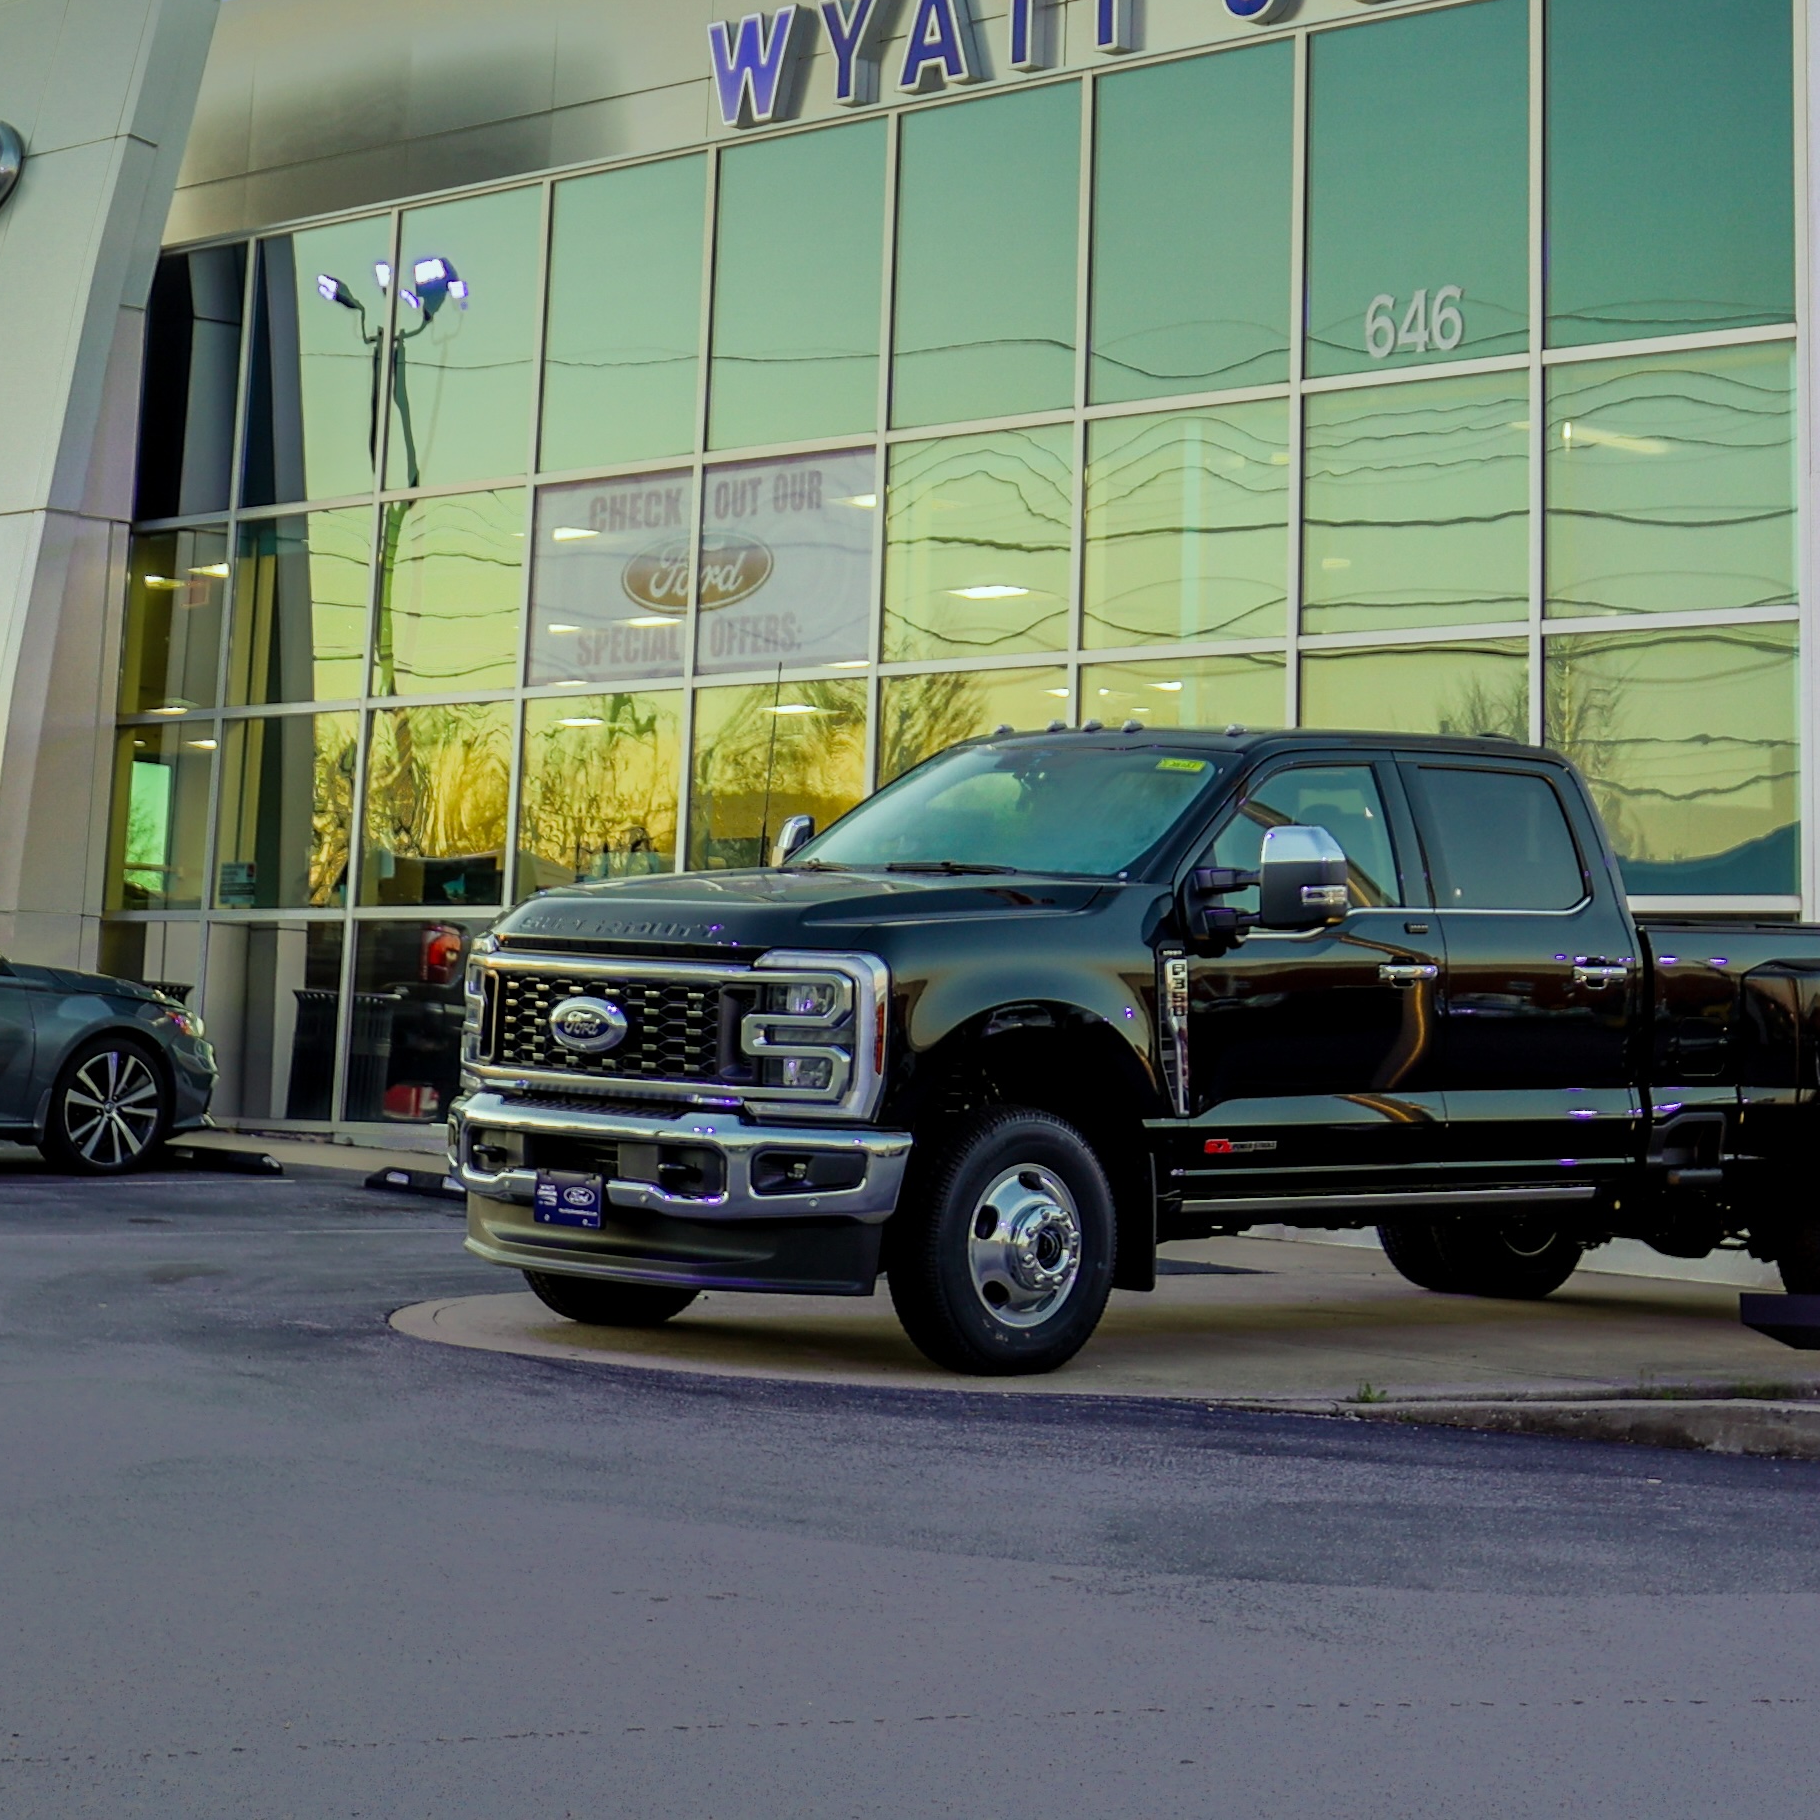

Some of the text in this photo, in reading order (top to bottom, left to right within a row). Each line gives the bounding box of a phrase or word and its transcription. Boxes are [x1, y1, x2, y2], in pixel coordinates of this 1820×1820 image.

[1365, 284, 1464, 358] 646
[588, 470, 823, 531] CHECK OUT OUR
[649, 540, 747, 598] Ford
[577, 612, 802, 667] SPECIAL OFFERS:
[563, 1010, 601, 1036] Ford
